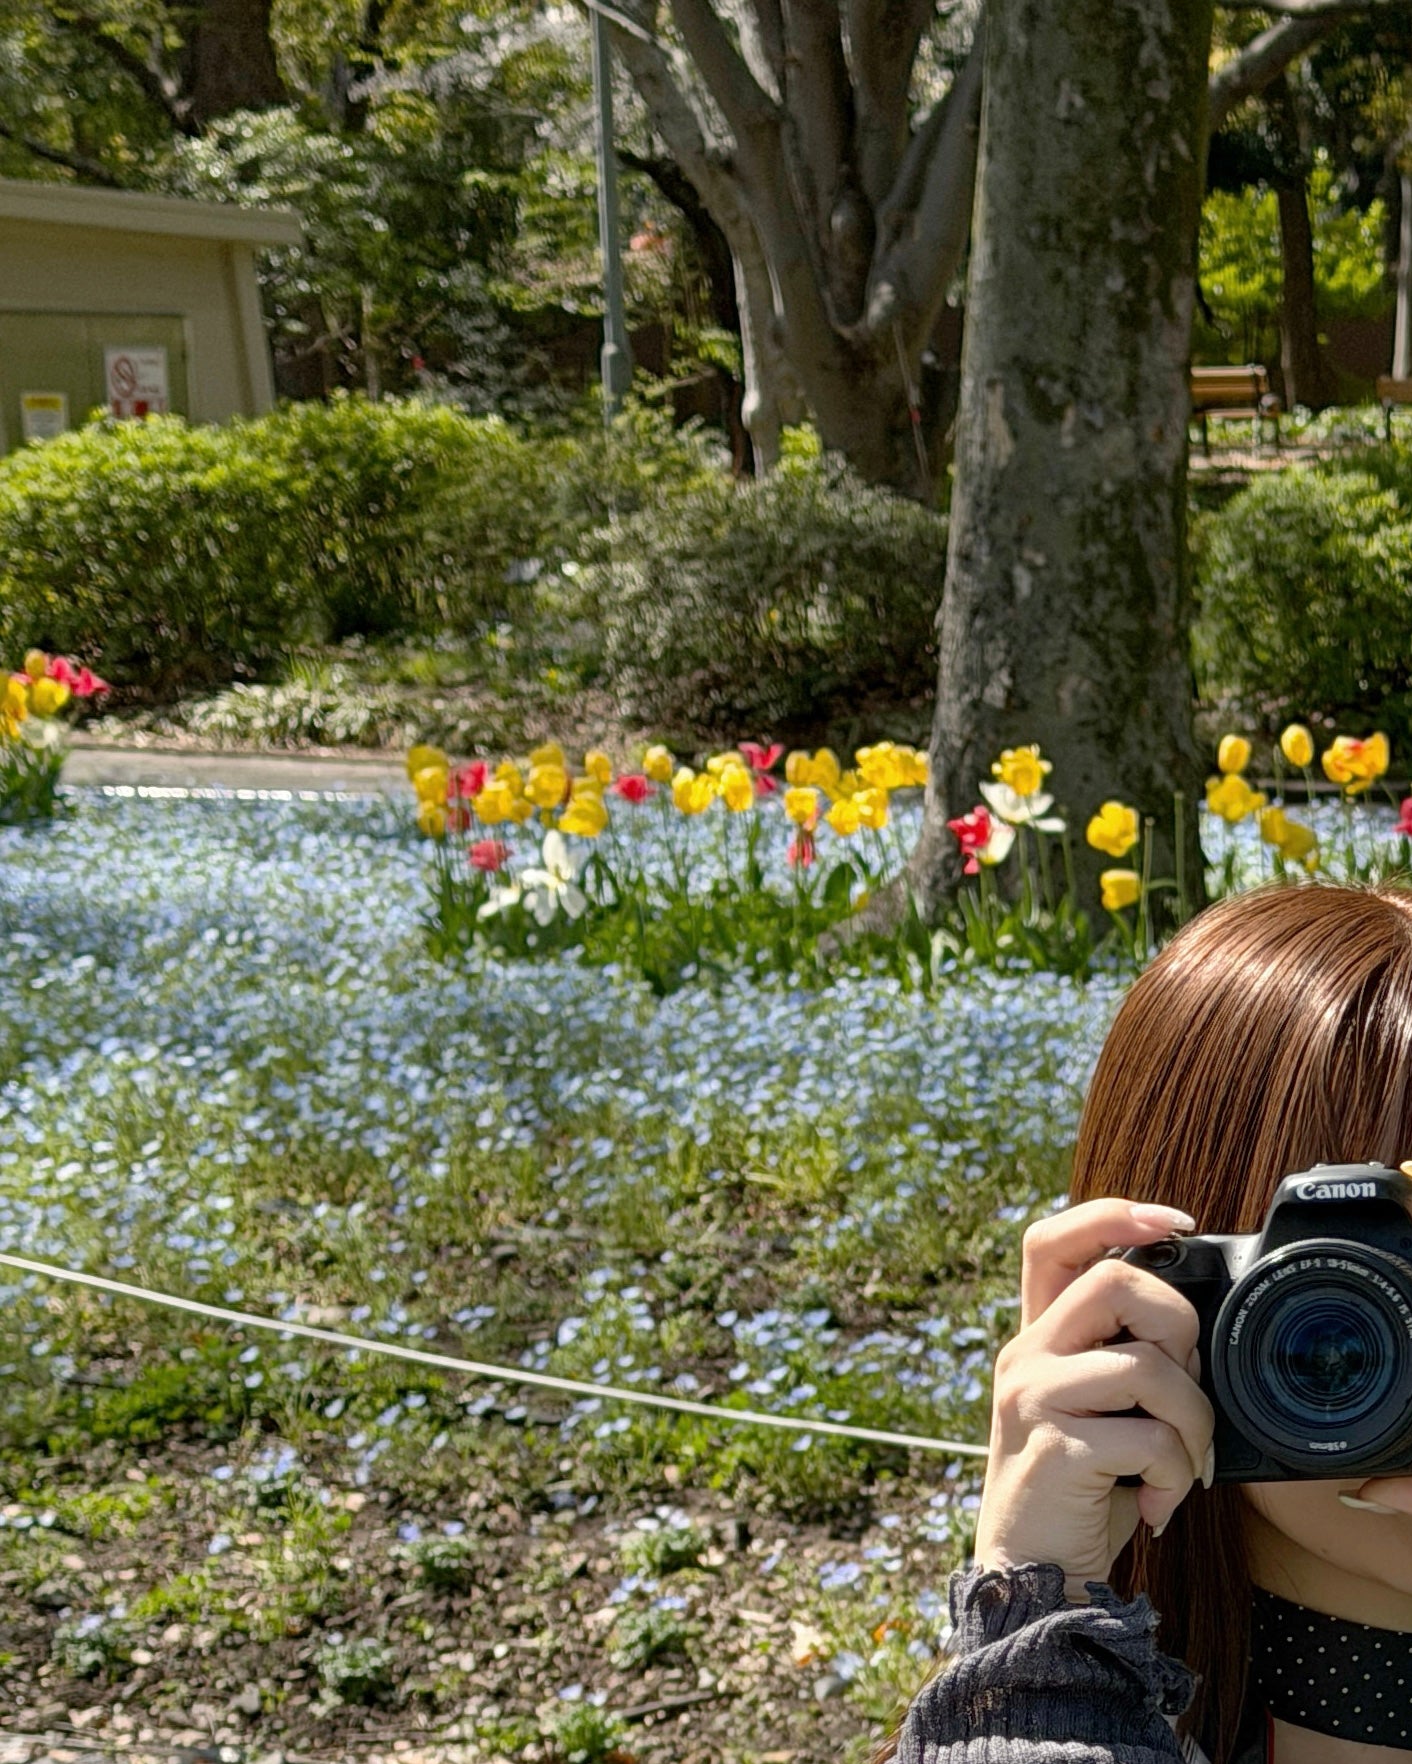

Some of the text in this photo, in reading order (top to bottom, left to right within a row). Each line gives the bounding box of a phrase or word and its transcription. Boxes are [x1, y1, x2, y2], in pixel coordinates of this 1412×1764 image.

[1296, 1182, 1376, 1200] Canon
[1229, 1309, 1249, 1345] CANON
[1244, 1279, 1271, 1307] ZOOM
[1271, 1264, 1296, 1281] LENS
